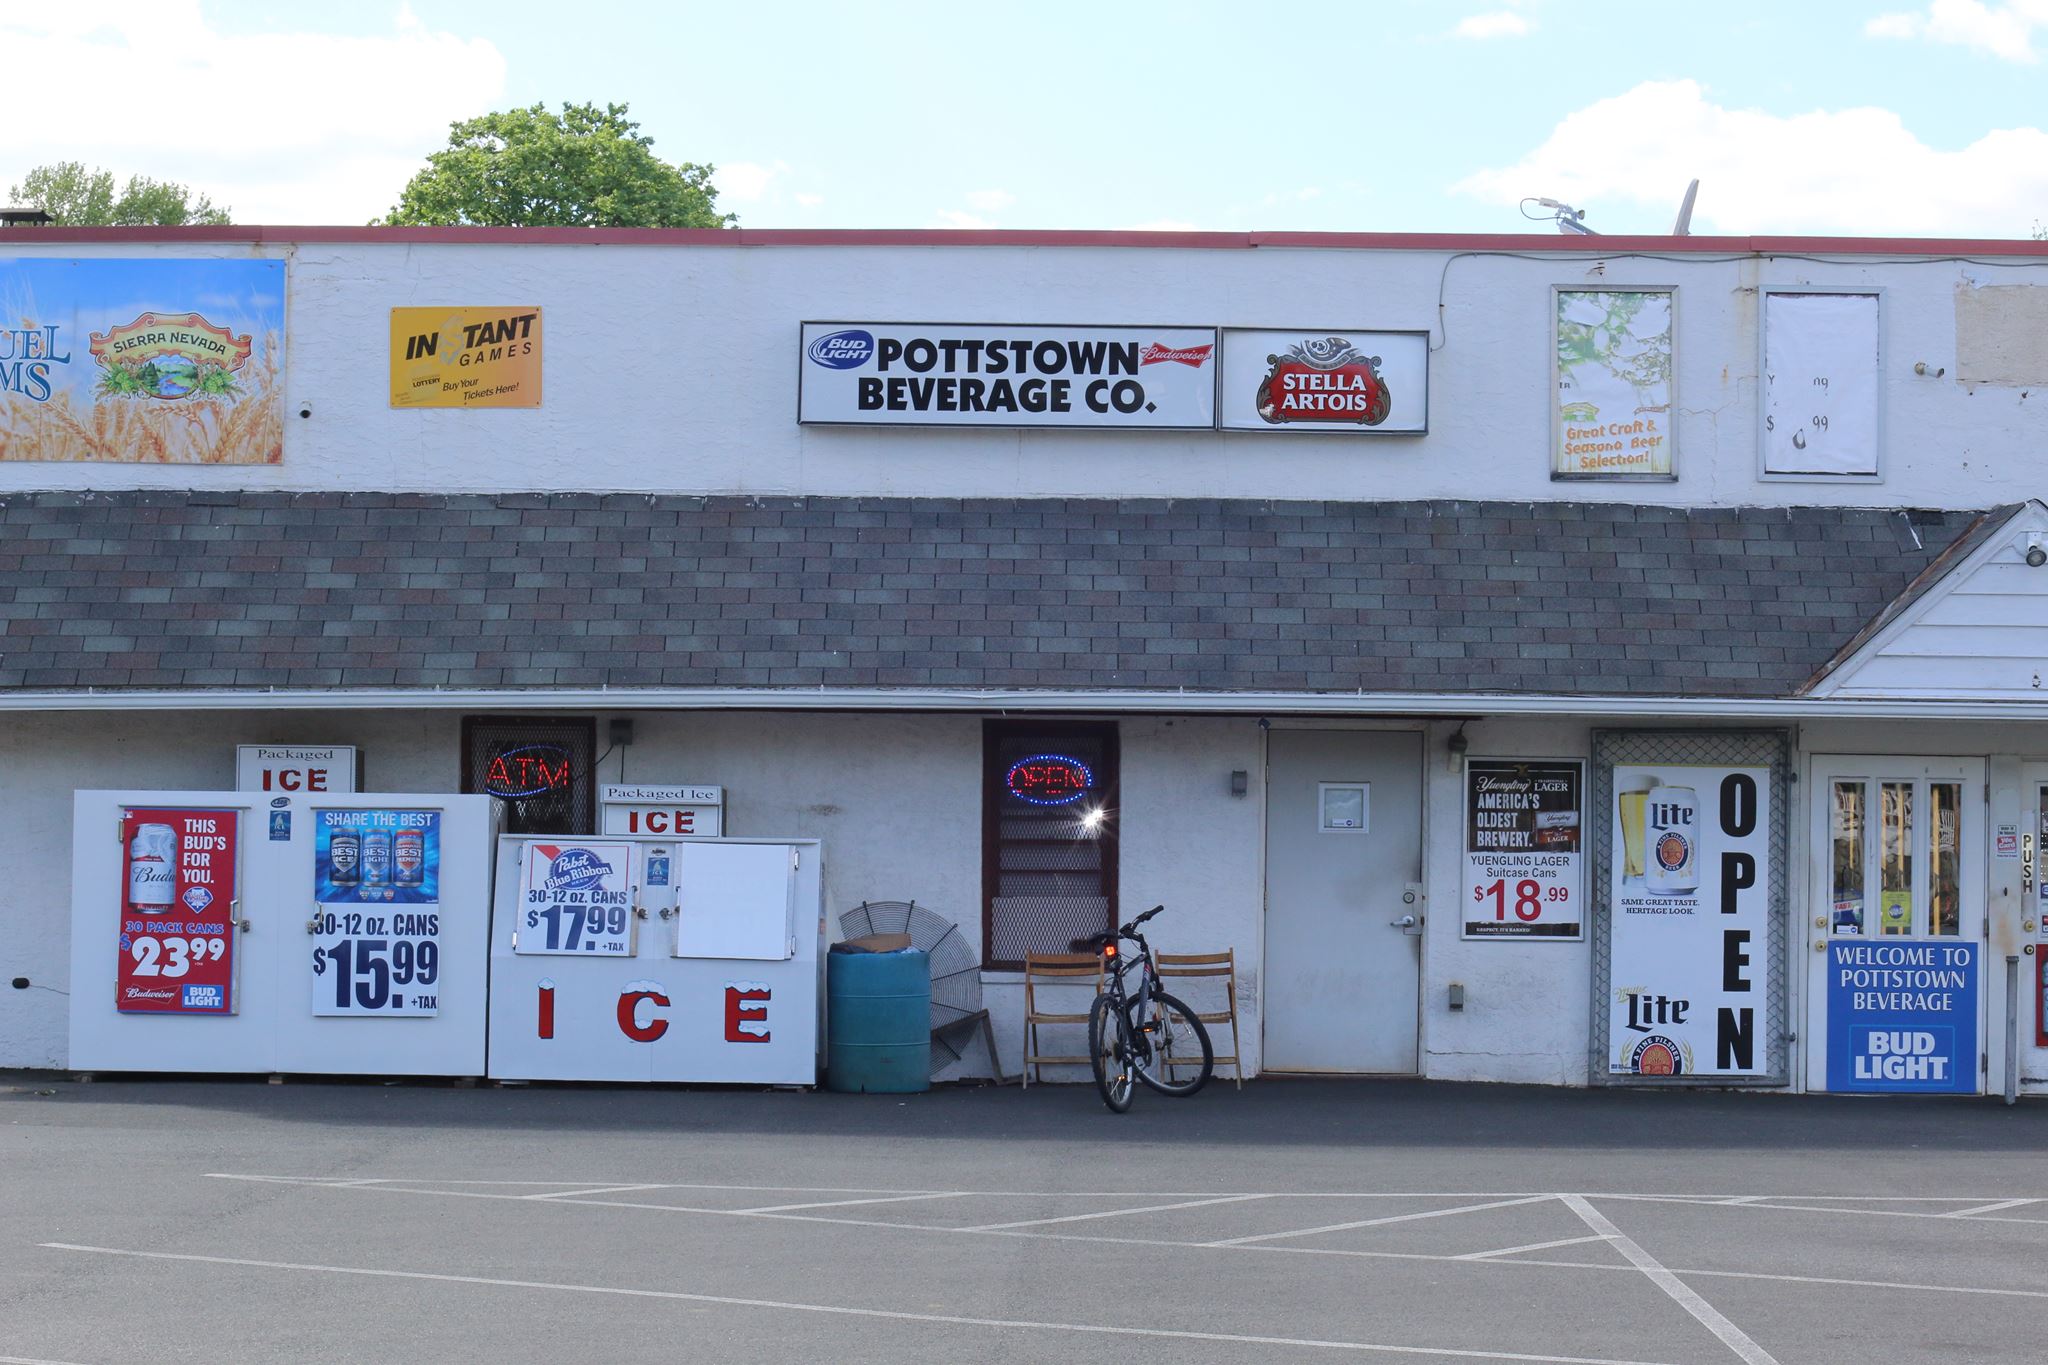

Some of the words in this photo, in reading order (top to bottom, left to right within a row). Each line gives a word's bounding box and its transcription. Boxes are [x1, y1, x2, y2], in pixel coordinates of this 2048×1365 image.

[113, 332, 166, 353] SIERRA
[170, 331, 226, 355] NEVADA
[828, 338, 866, 349] BUD
[459, 342, 532, 367] GAMES
[818, 348, 871, 359] LIGHT
[878, 338, 1139, 375] POTTSTOWN
[1140, 346, 1212, 360] Budweiser
[443, 382, 459, 392] Buy
[460, 377, 480, 388] Your
[1282, 373, 1367, 391] STELLA
[464, 388, 494, 400] Tickets
[495, 382, 520, 396] Here!
[858, 377, 1073, 413] BEVERAGE
[1085, 379, 1158, 414] CO.
[1281, 393, 1367, 411] ARTOIS
[1566, 425, 1605, 440] Great
[1609, 419, 1644, 436] Craft
[1631, 435, 1663, 449] Beer
[257, 749, 334, 761] Packaged
[262, 768, 328, 792] ICE
[487, 757, 569, 787] ATM
[1010, 766, 1084, 794] OPEN
[1475, 776, 1531, 792] Yuengling
[1534, 783, 1568, 791] LAGER
[607, 788, 686, 800] Packaged
[690, 789, 715, 799] Ice
[1477, 793, 1540, 809] AMERICA'S
[325, 813, 368, 825] SHARE
[372, 813, 397, 826] THE
[401, 813, 433, 826] BEST
[628, 810, 695, 834] ICE
[1477, 812, 1518, 828] OLDEST
[1651, 803, 1693, 831] Lite
[184, 819, 216, 833] THIS
[184, 835, 226, 850] BUD'S
[1477, 831, 1533, 847] BREWERY.
[183, 852, 211, 866] FOR
[332, 848, 358, 856] BEST
[363, 848, 390, 856] BEST
[396, 848, 422, 856] BEST
[555, 854, 589, 873] Pabst
[1471, 855, 1531, 866] YUENGLING
[1534, 856, 1570, 866] LAGER
[2023, 834, 2033, 893] PUSH
[183, 869, 214, 883] YOU.
[546, 874, 571, 889] Blue
[570, 866, 610, 880] Ribbon
[1486, 867, 1529, 878] Suitcase
[1532, 868, 1557, 878] Cans
[529, 890, 567, 903] 30-12
[591, 891, 627, 904] CANS
[125, 921, 143, 932] 30
[146, 922, 183, 933] PACK
[186, 923, 224, 934] CANS
[393, 914, 439, 937] CANS
[1716, 773, 1757, 1070] OPEN
[1836, 946, 1935, 966] WELCOME
[1943, 948, 1970, 966] TO
[1841, 970, 1965, 989] POTTSTOWN
[126, 987, 175, 998] Budweiser
[189, 987, 216, 997] BUD
[184, 996, 221, 1006] LIGHT
[1853, 992, 1952, 1011] BEVERAGE
[538, 979, 772, 1043] ICE
[1625, 994, 1690, 1033] Lite
[1636, 1038, 1655, 1053] FINE
[1655, 1037, 1680, 1062] PILSNER
[1868, 1031, 1936, 1055] BUD
[1855, 1056, 1948, 1080] LIGHT
